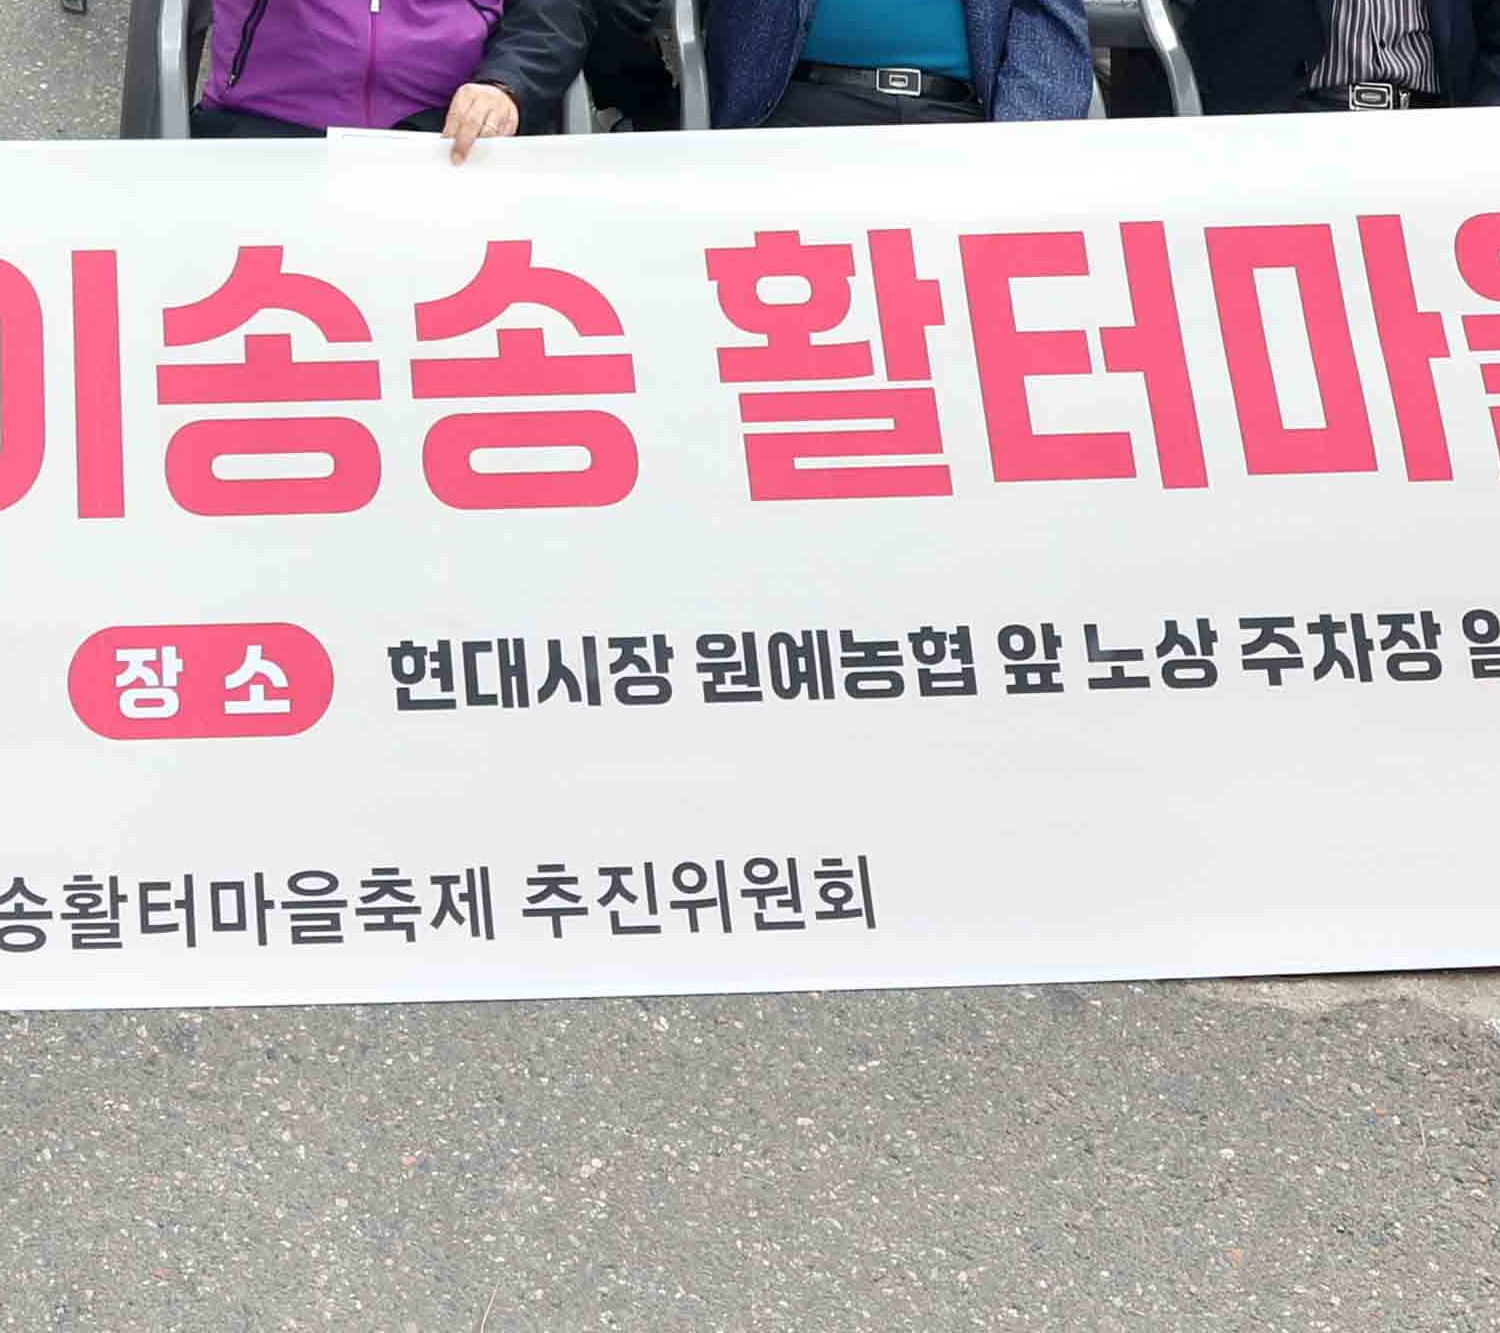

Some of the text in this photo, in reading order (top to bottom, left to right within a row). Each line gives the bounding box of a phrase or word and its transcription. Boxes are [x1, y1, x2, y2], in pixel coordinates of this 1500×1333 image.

[388, 635, 673, 710] 현대시장
[697, 626, 976, 702] 원예농협
[998, 623, 1063, 693] 앞
[1084, 619, 1217, 689] 노상
[1240, 612, 1441, 685] 주차장
[523, 856, 875, 937] 추진위원회
